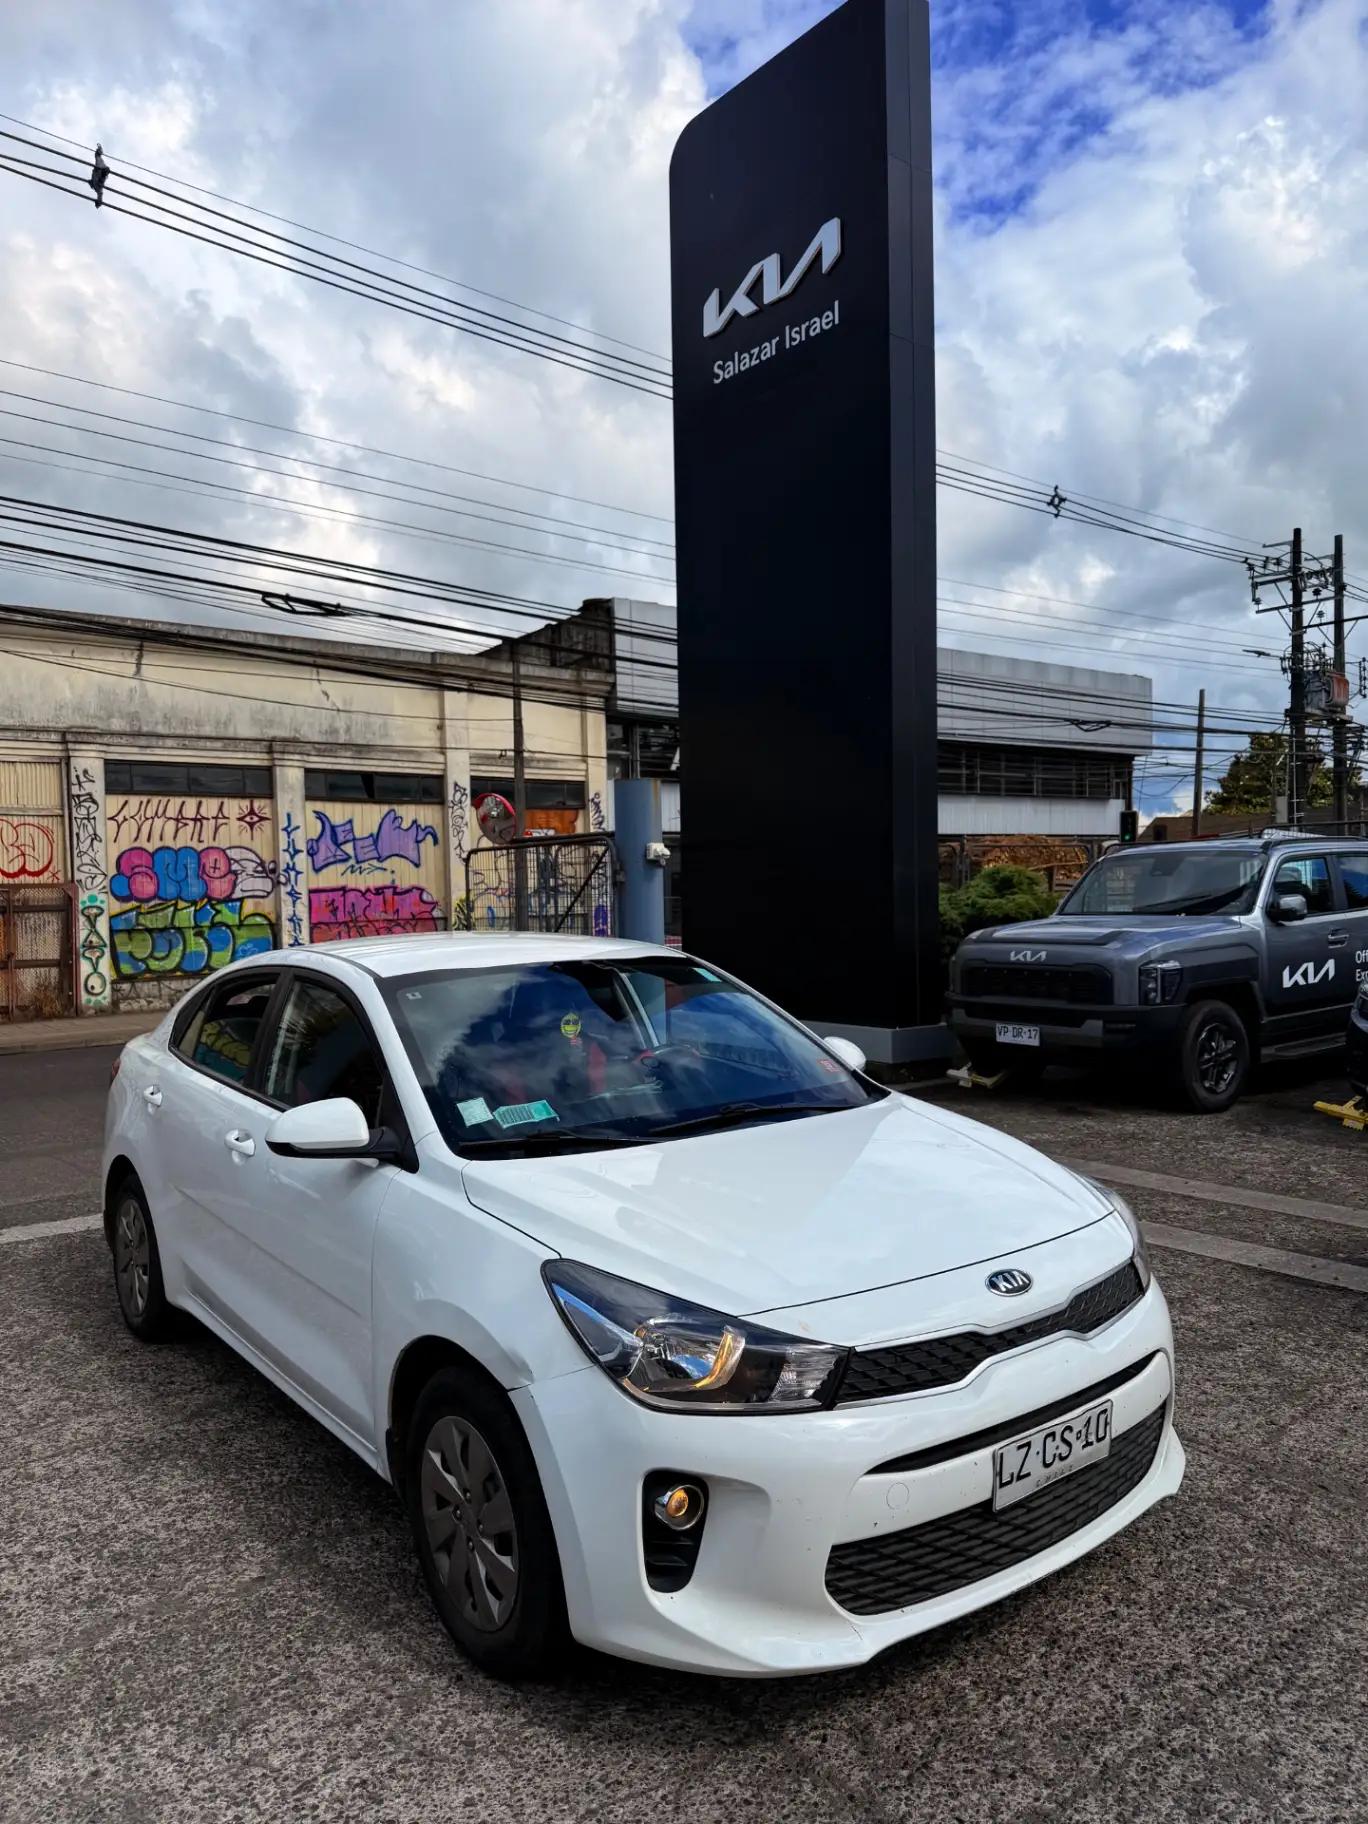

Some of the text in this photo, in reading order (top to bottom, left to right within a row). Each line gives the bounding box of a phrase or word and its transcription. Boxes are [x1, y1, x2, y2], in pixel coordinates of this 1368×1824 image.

[703, 216, 841, 338] KIA
[713, 299, 840, 384] Salazar Israel
[1010, 950, 1047, 961] KIA
[1282, 958, 1335, 988] KIA
[991, 1270, 1030, 1291] KIA
